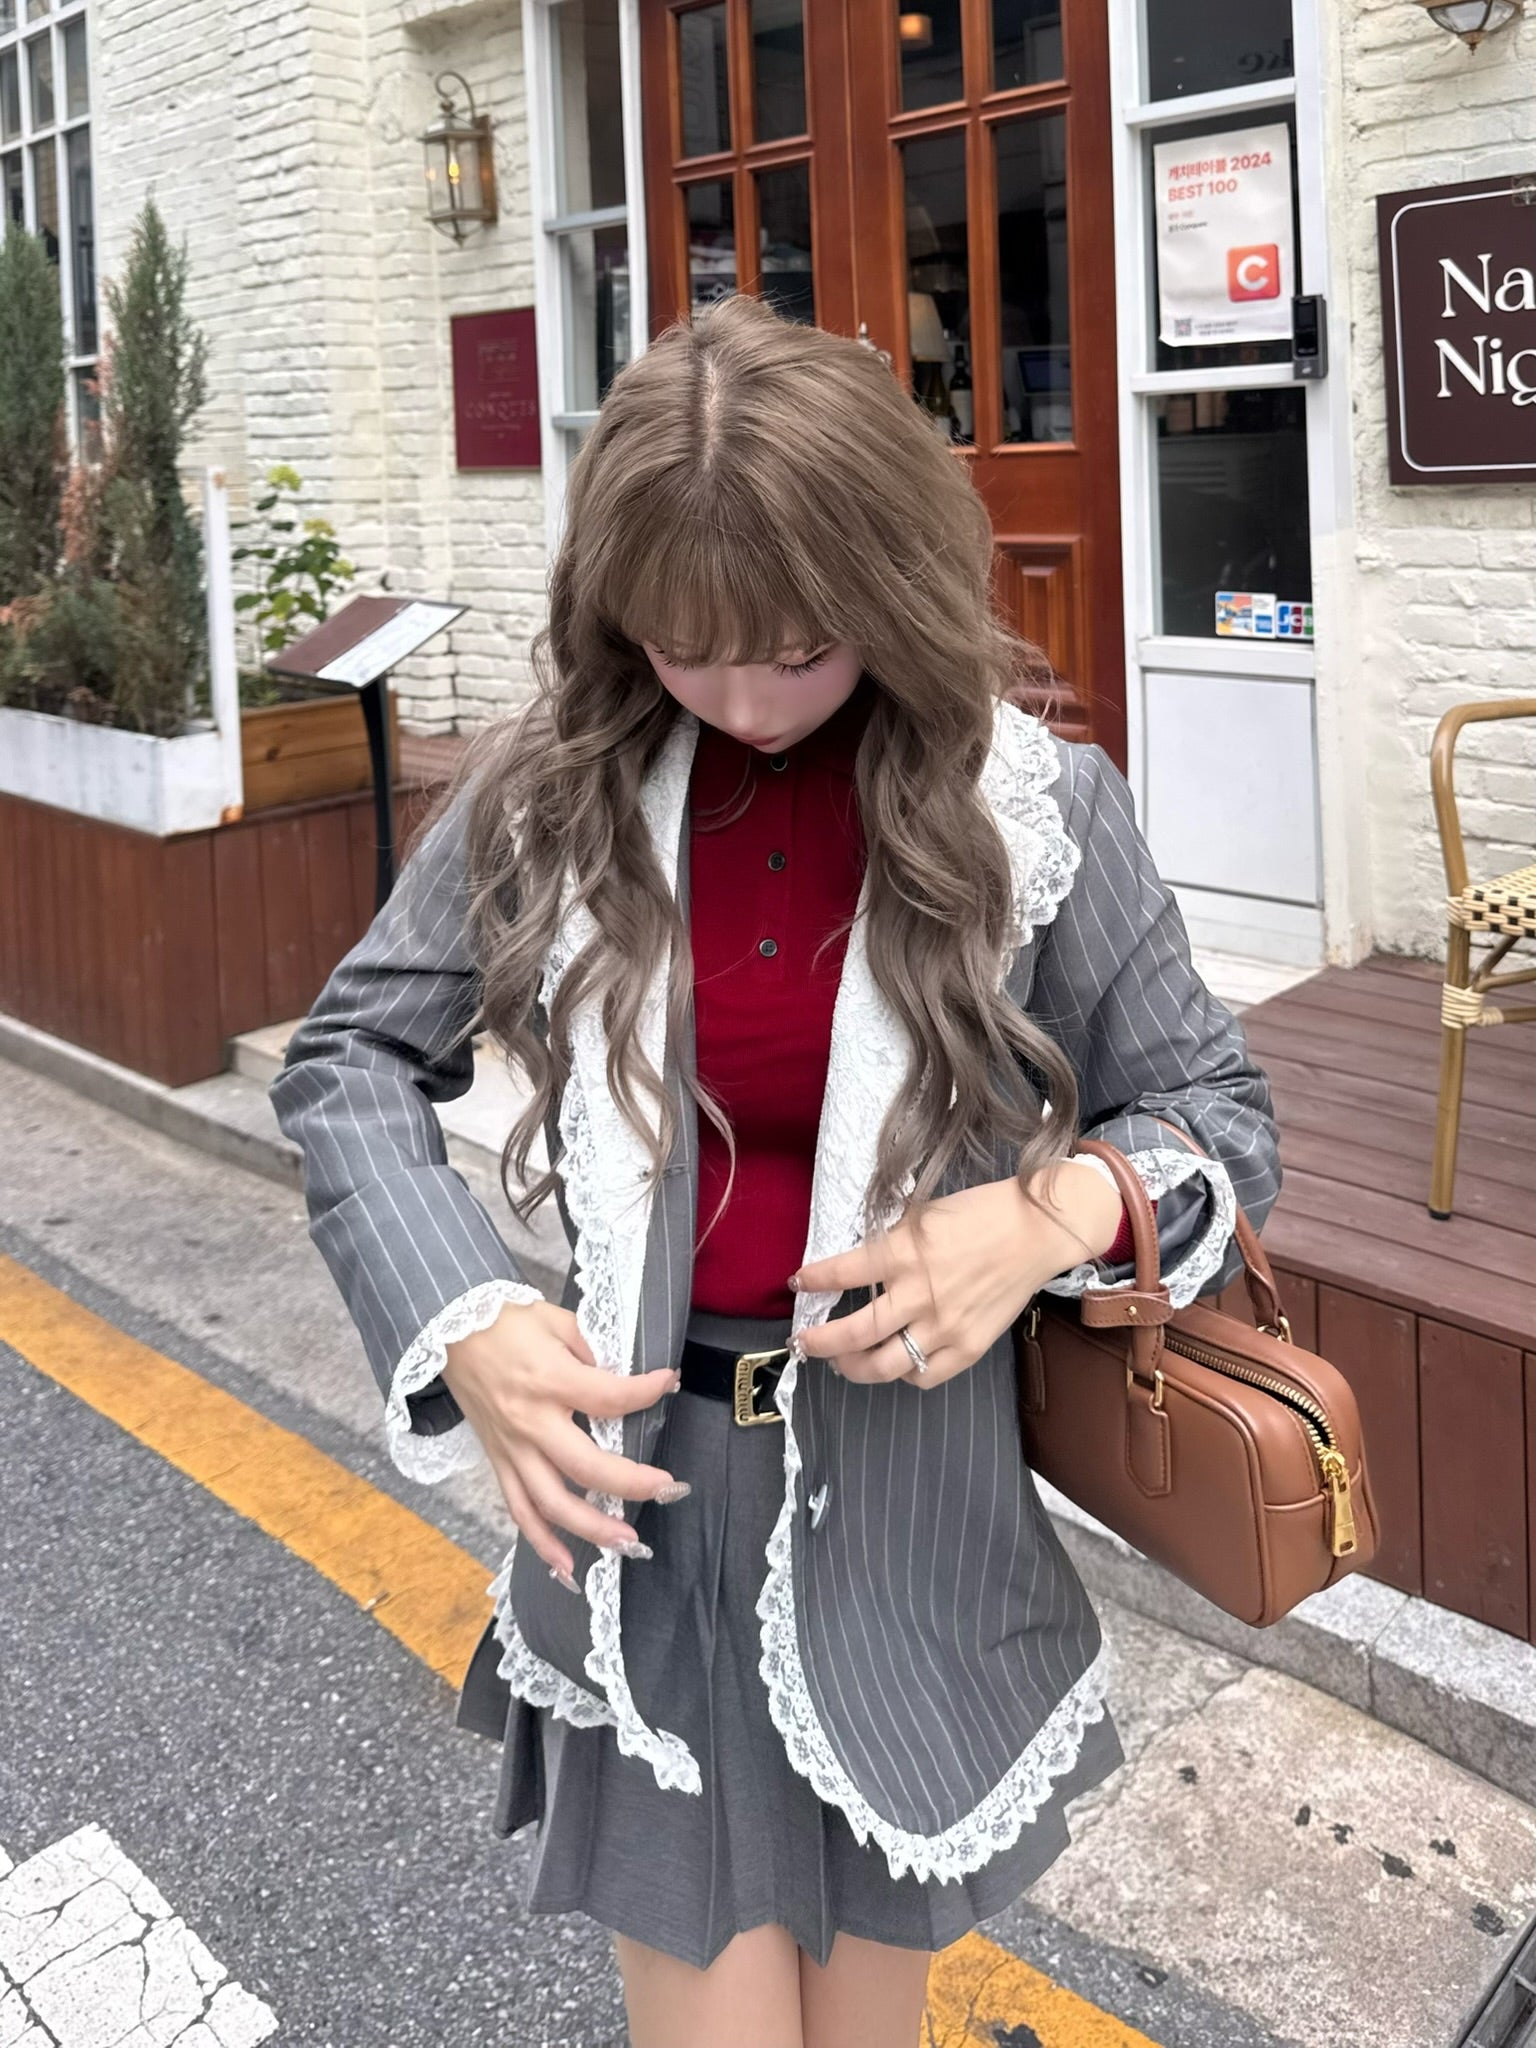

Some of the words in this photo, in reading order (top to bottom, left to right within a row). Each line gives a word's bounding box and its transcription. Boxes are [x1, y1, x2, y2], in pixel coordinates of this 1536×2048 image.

[1230, 151, 1272, 171] 2024
[1168, 183, 1204, 203] BEST
[1208, 178, 1238, 196] 100
[1236, 255, 1269, 291] C
[1438, 253, 1536, 319] Na
